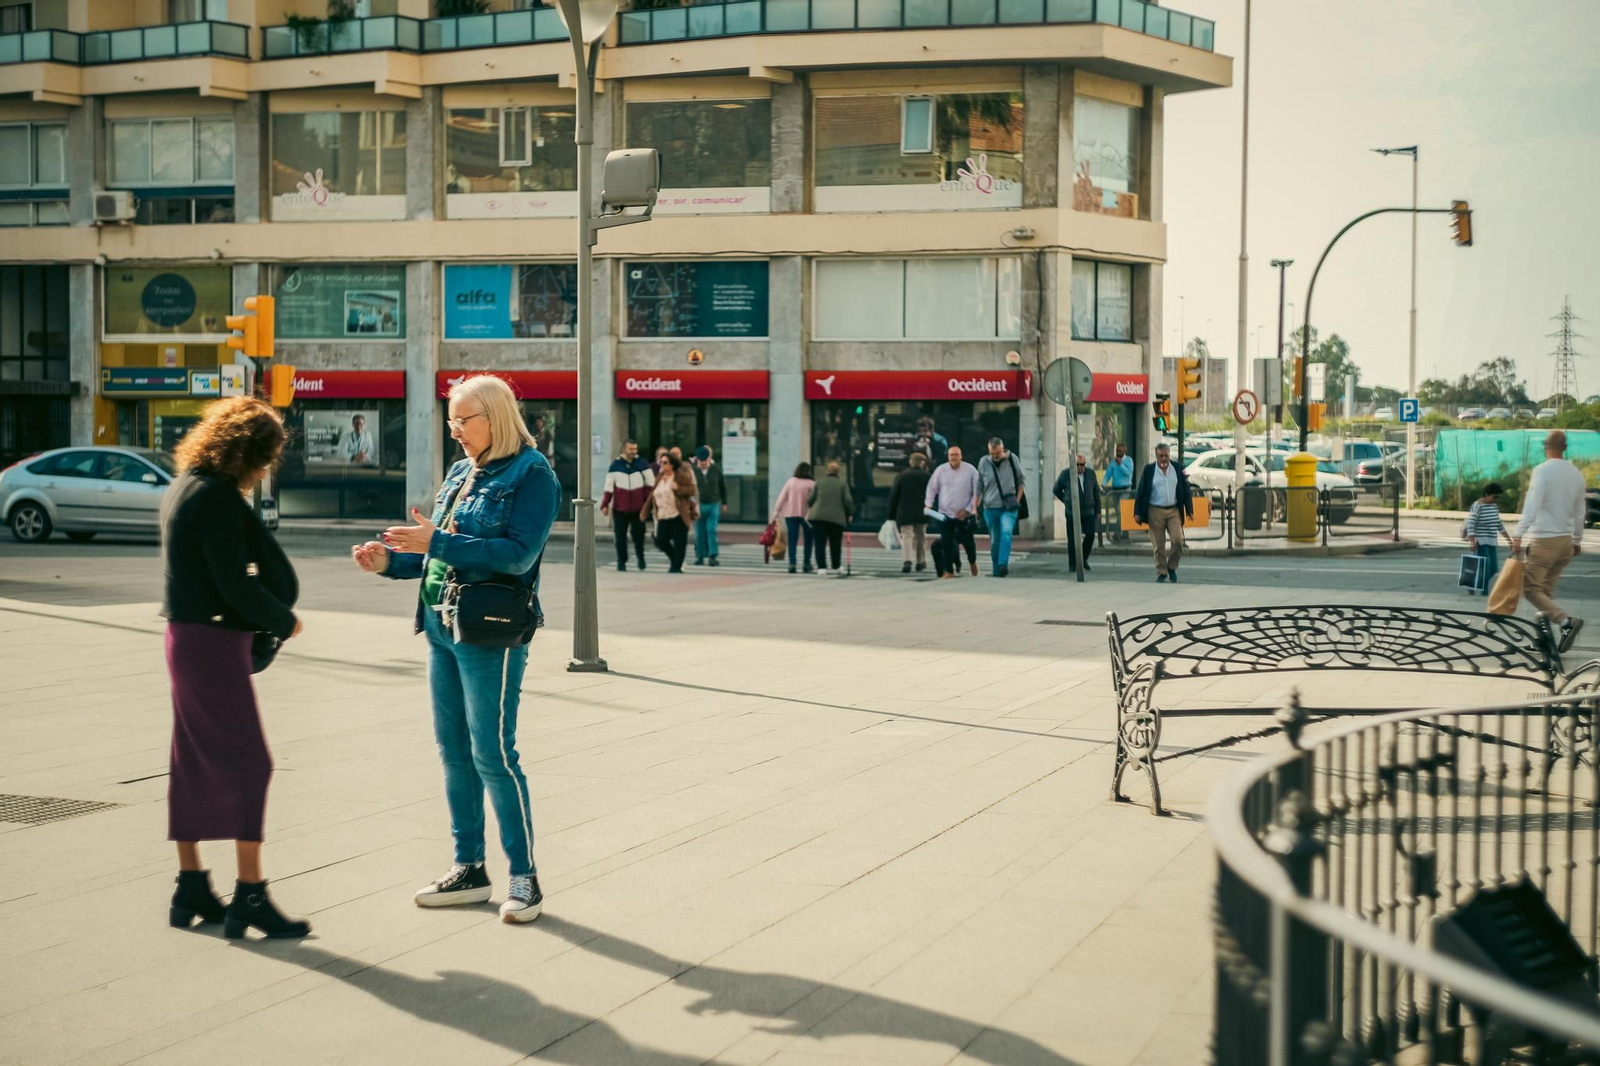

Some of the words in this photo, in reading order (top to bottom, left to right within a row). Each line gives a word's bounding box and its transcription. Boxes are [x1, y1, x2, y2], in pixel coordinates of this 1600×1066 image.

[456, 288, 496, 304] alfa
[291, 377, 324, 391] ident
[626, 377, 682, 391] Occident
[948, 378, 1008, 392] Occident
[1116, 380, 1144, 395] Occident
[1403, 402, 1415, 420] P
